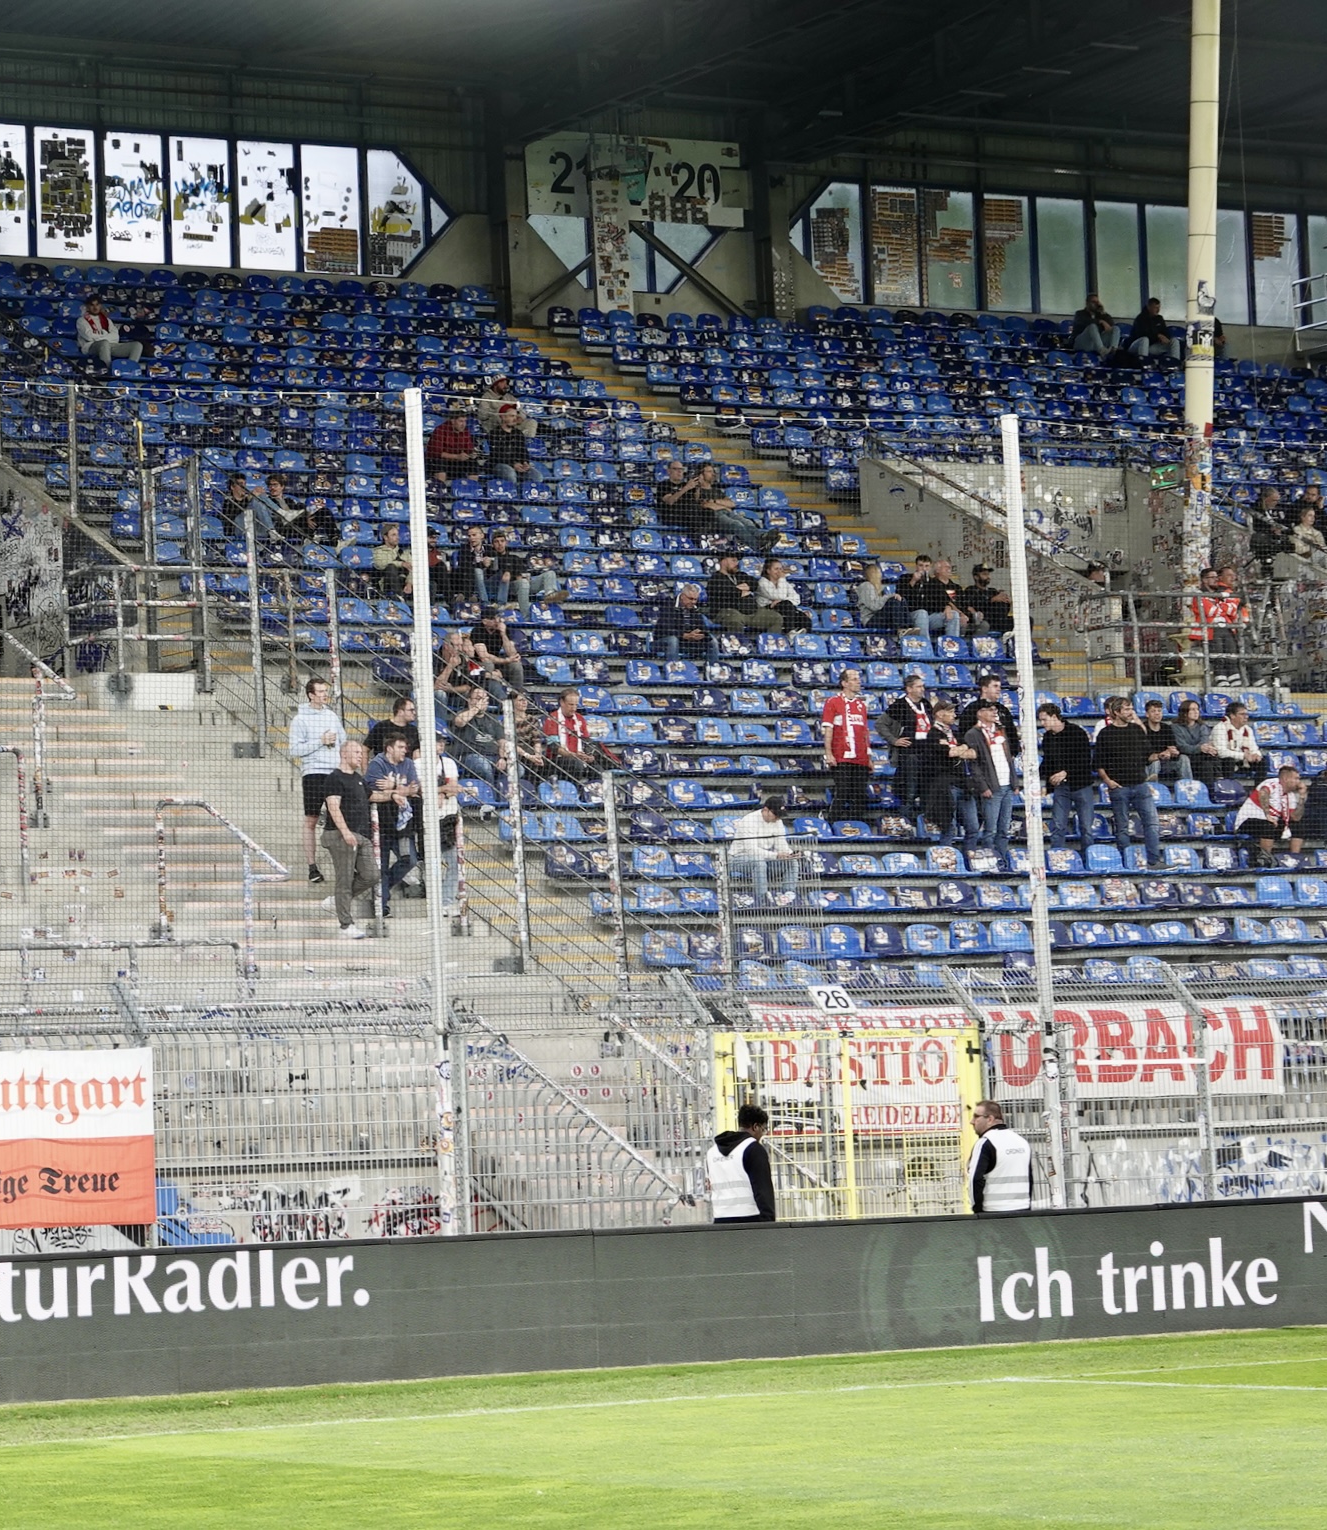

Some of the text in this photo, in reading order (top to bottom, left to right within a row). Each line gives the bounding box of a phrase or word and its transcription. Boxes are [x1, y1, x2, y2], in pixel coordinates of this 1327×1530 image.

[672, 162, 720, 206] 20
[817, 989, 850, 1009] 26
[769, 1040, 959, 1086] BASTIO
[39, 1167, 120, 1195] Treue
[977, 1237, 1279, 1322] Ich trinke
